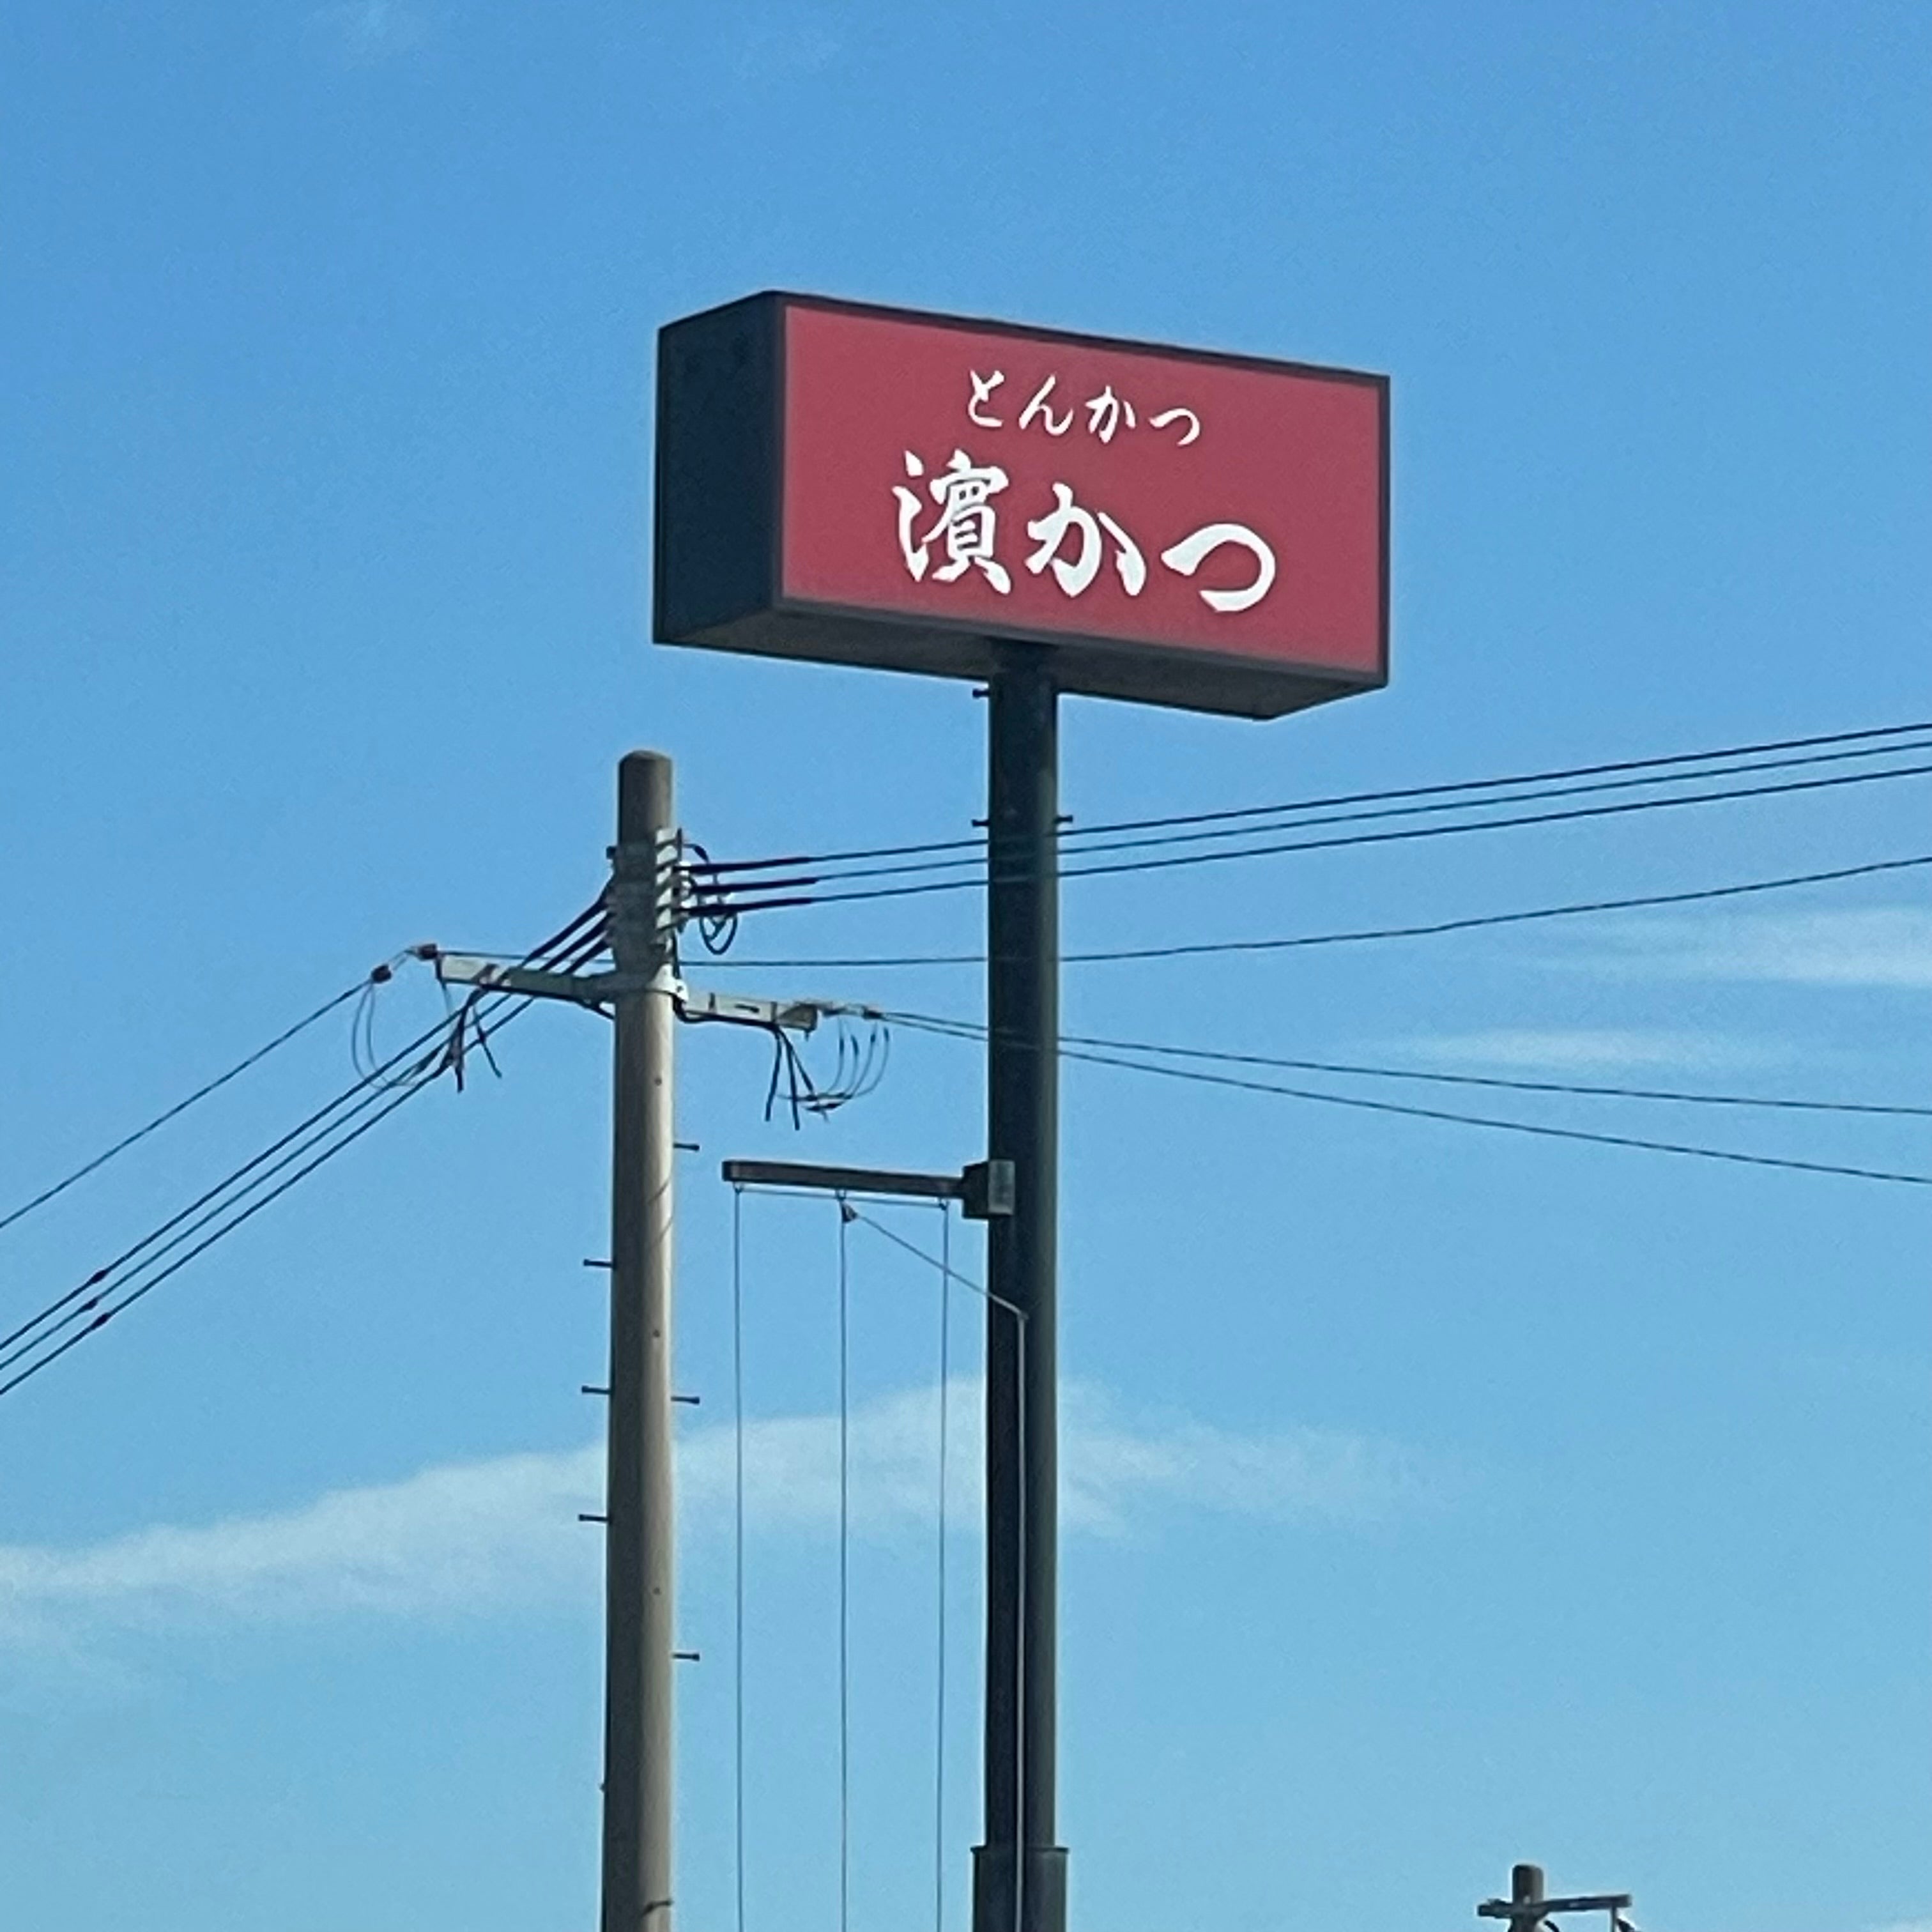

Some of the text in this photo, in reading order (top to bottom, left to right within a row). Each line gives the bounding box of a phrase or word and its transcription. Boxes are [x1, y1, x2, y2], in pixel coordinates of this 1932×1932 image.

[969, 370, 1201, 446] とんかつ
[892, 449, 1276, 612] 濱かつ
